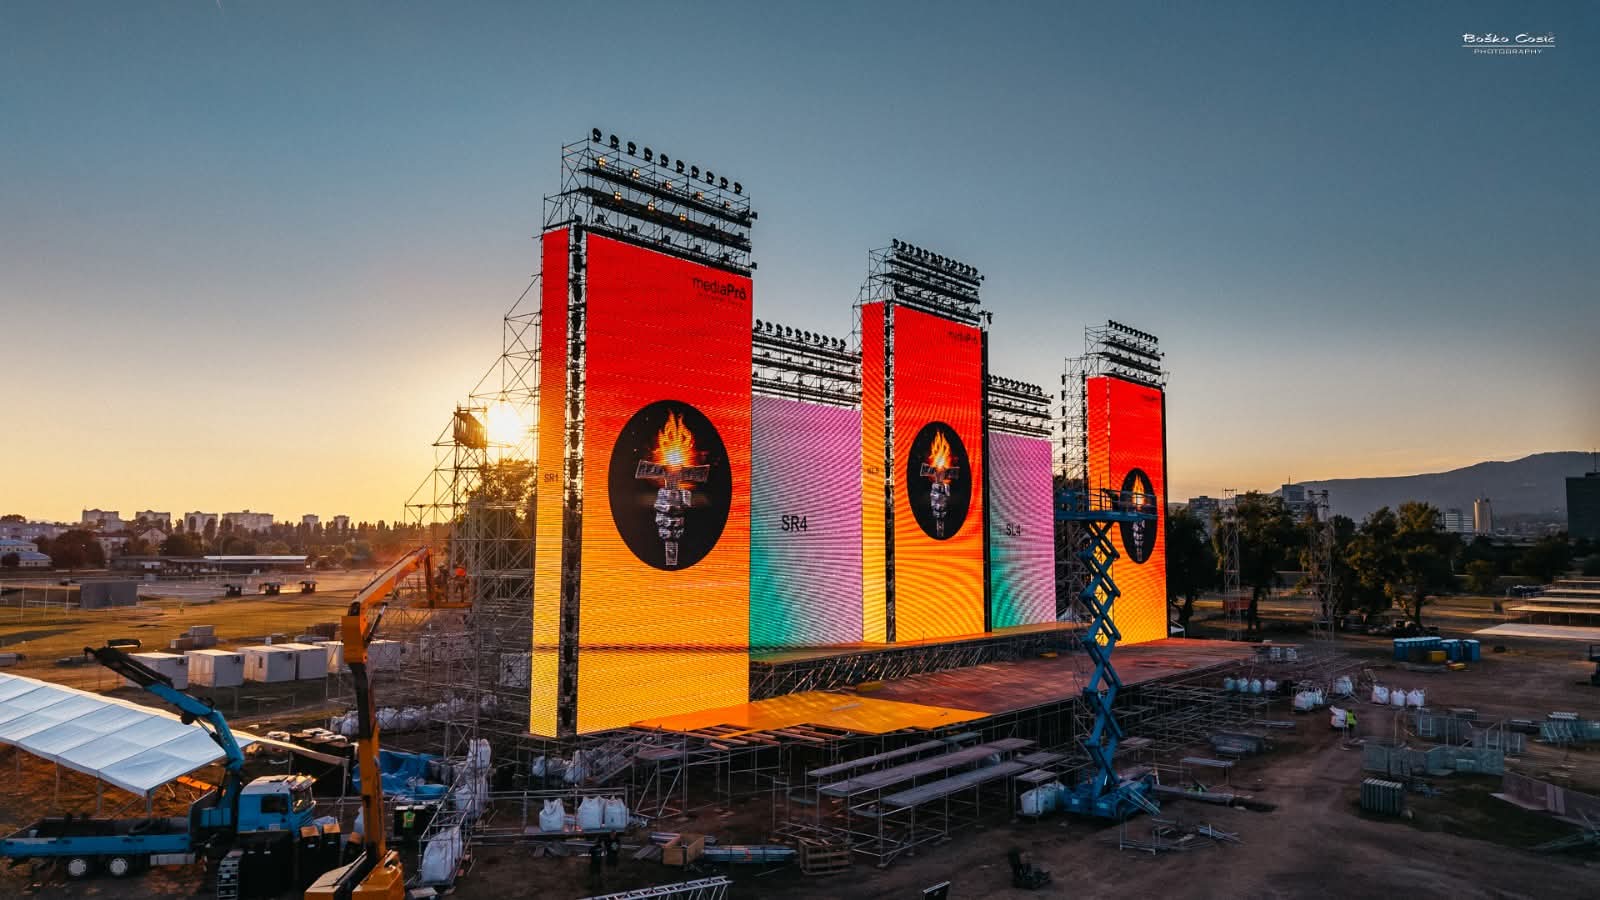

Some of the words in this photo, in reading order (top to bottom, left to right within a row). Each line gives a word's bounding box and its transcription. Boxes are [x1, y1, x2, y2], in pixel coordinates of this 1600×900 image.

[543, 473, 559, 483] SR1
[781, 514, 808, 532] SR4
[1006, 523, 1021, 537] SL4
